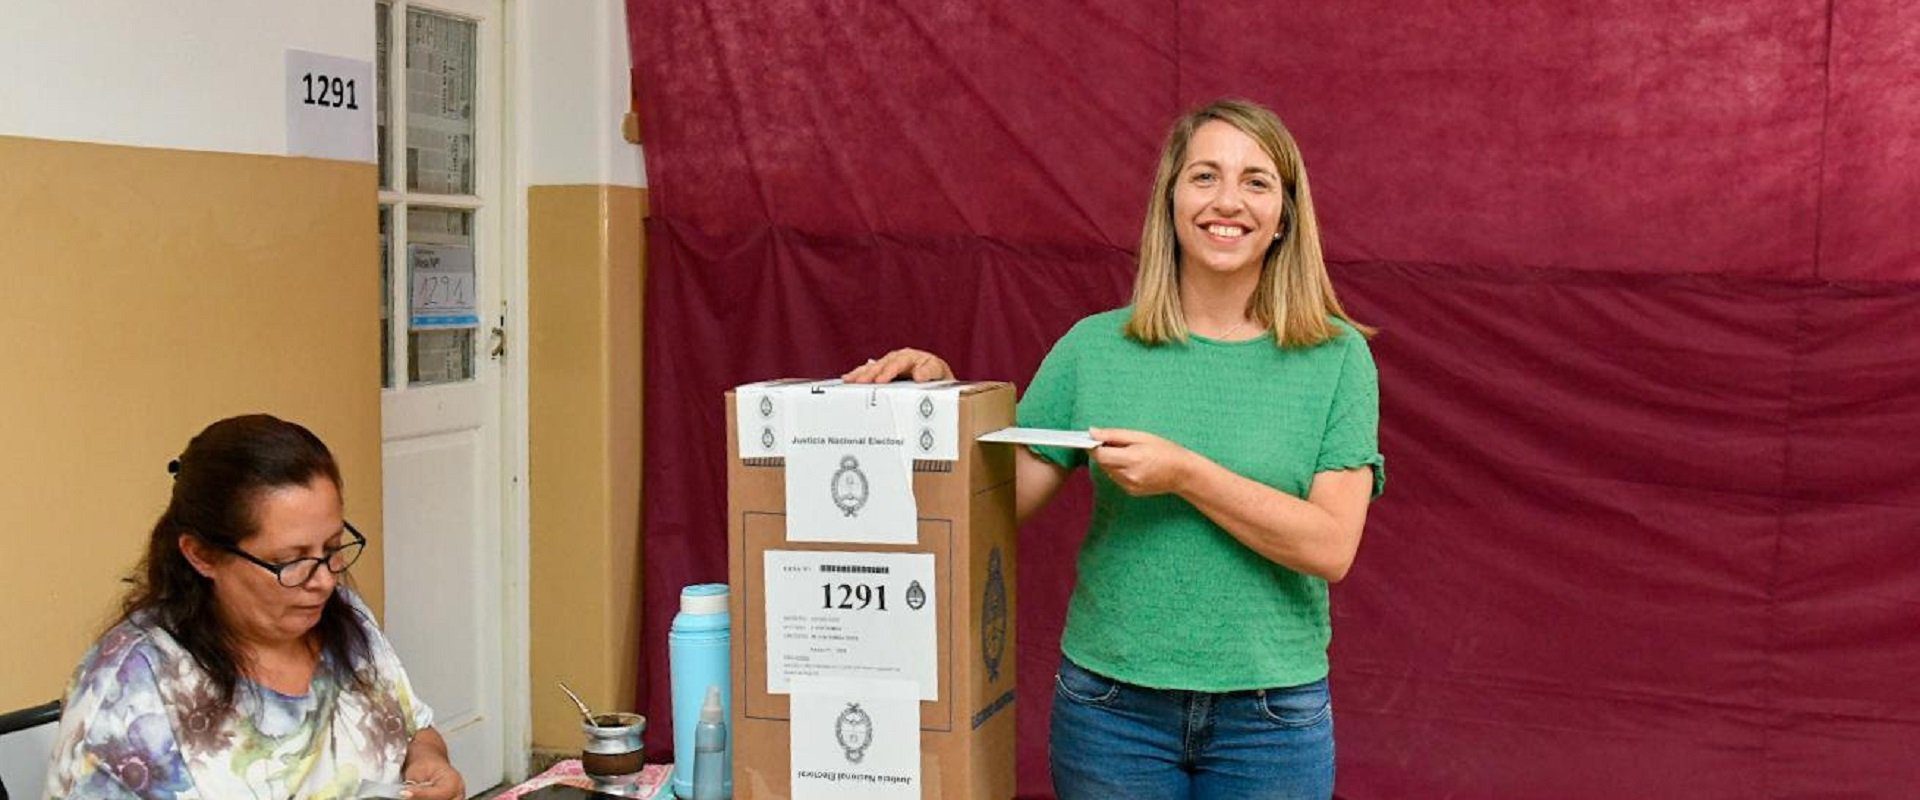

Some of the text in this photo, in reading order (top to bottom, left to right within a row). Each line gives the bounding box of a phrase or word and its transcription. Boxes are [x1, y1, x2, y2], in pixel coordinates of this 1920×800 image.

[301, 72, 358, 110] 1291
[791, 435, 826, 445] Justicia
[828, 437, 866, 445] Nacional
[822, 583, 888, 611] 1291
[797, 770, 912, 786] Justicia Nacional Electoral
